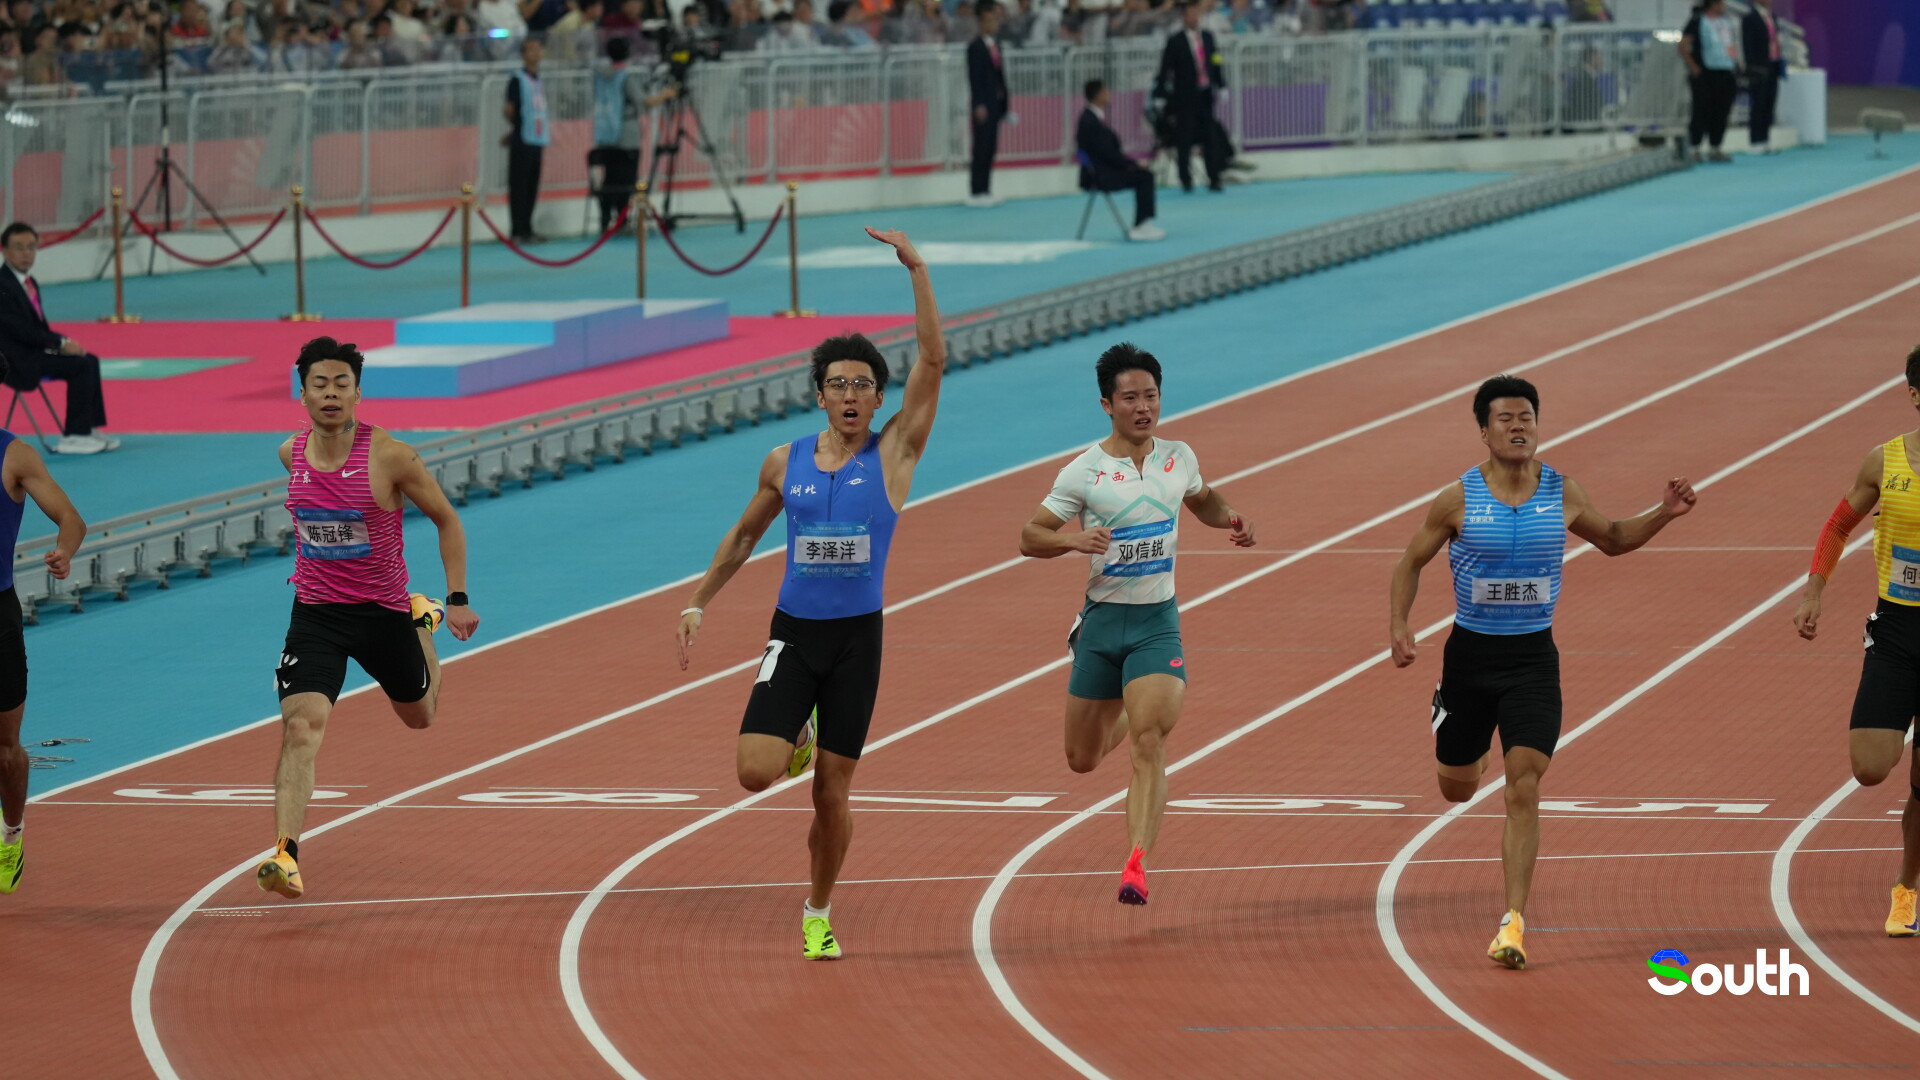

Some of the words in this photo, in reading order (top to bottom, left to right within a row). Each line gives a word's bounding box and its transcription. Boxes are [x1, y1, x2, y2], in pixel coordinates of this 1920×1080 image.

[1094, 470, 1125, 486] 广西
[789, 484, 817, 496] 湖北
[307, 524, 355, 542] 陈冠锋
[806, 540, 856, 560] 李泽洋
[1119, 538, 1164, 562] 邓信锐
[1902, 564, 1920, 584] 何
[1486, 582, 1538, 601] 王胜杰
[457, 792, 700, 803] 8
